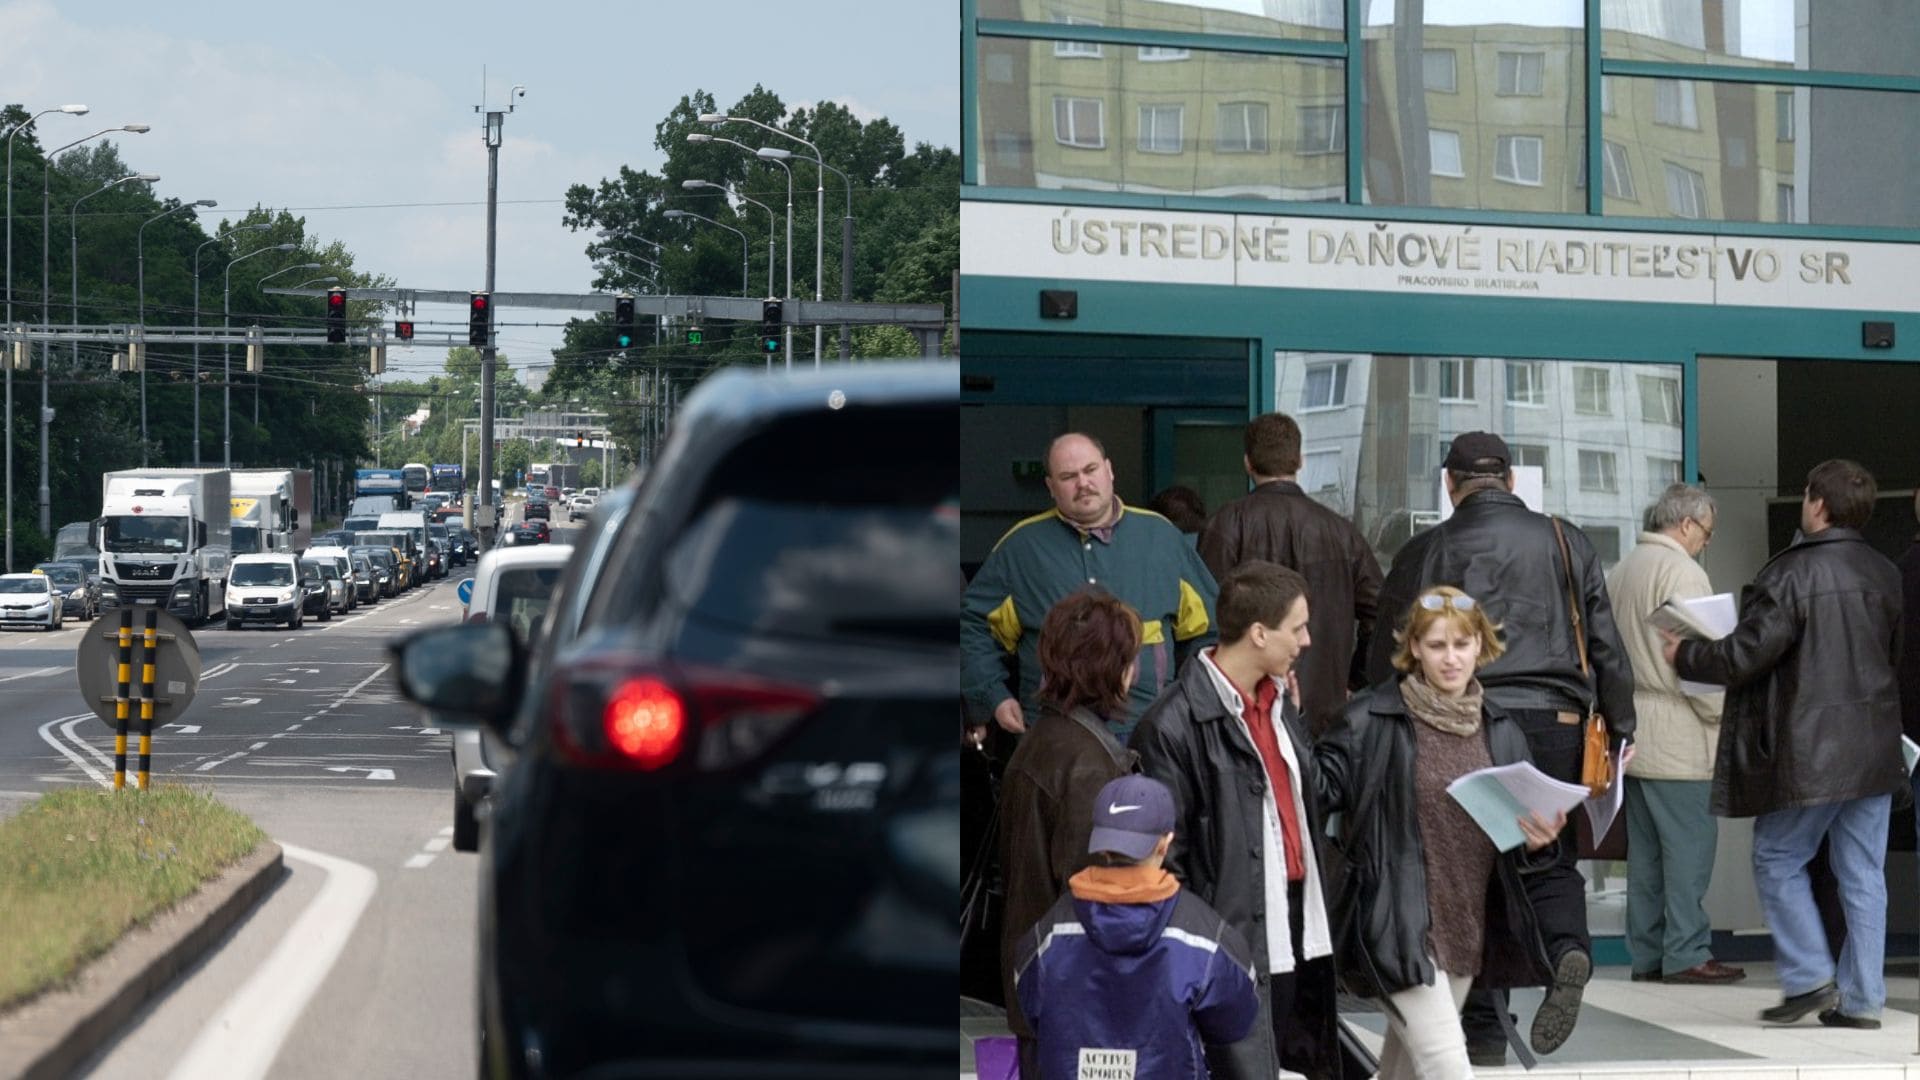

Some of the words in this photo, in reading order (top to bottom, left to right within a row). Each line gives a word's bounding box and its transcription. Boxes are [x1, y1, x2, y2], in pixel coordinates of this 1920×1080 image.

[1051, 208, 1290, 263] ÚSTREDNÉ
[1307, 223, 1481, 271] DAŇOVÉ
[1497, 237, 1782, 283] RIADITEĽSTVO
[1799, 251, 1852, 285] SR
[1082, 1053, 1131, 1066] ACTIVE
[1081, 1067, 1132, 1080] SPORTS
